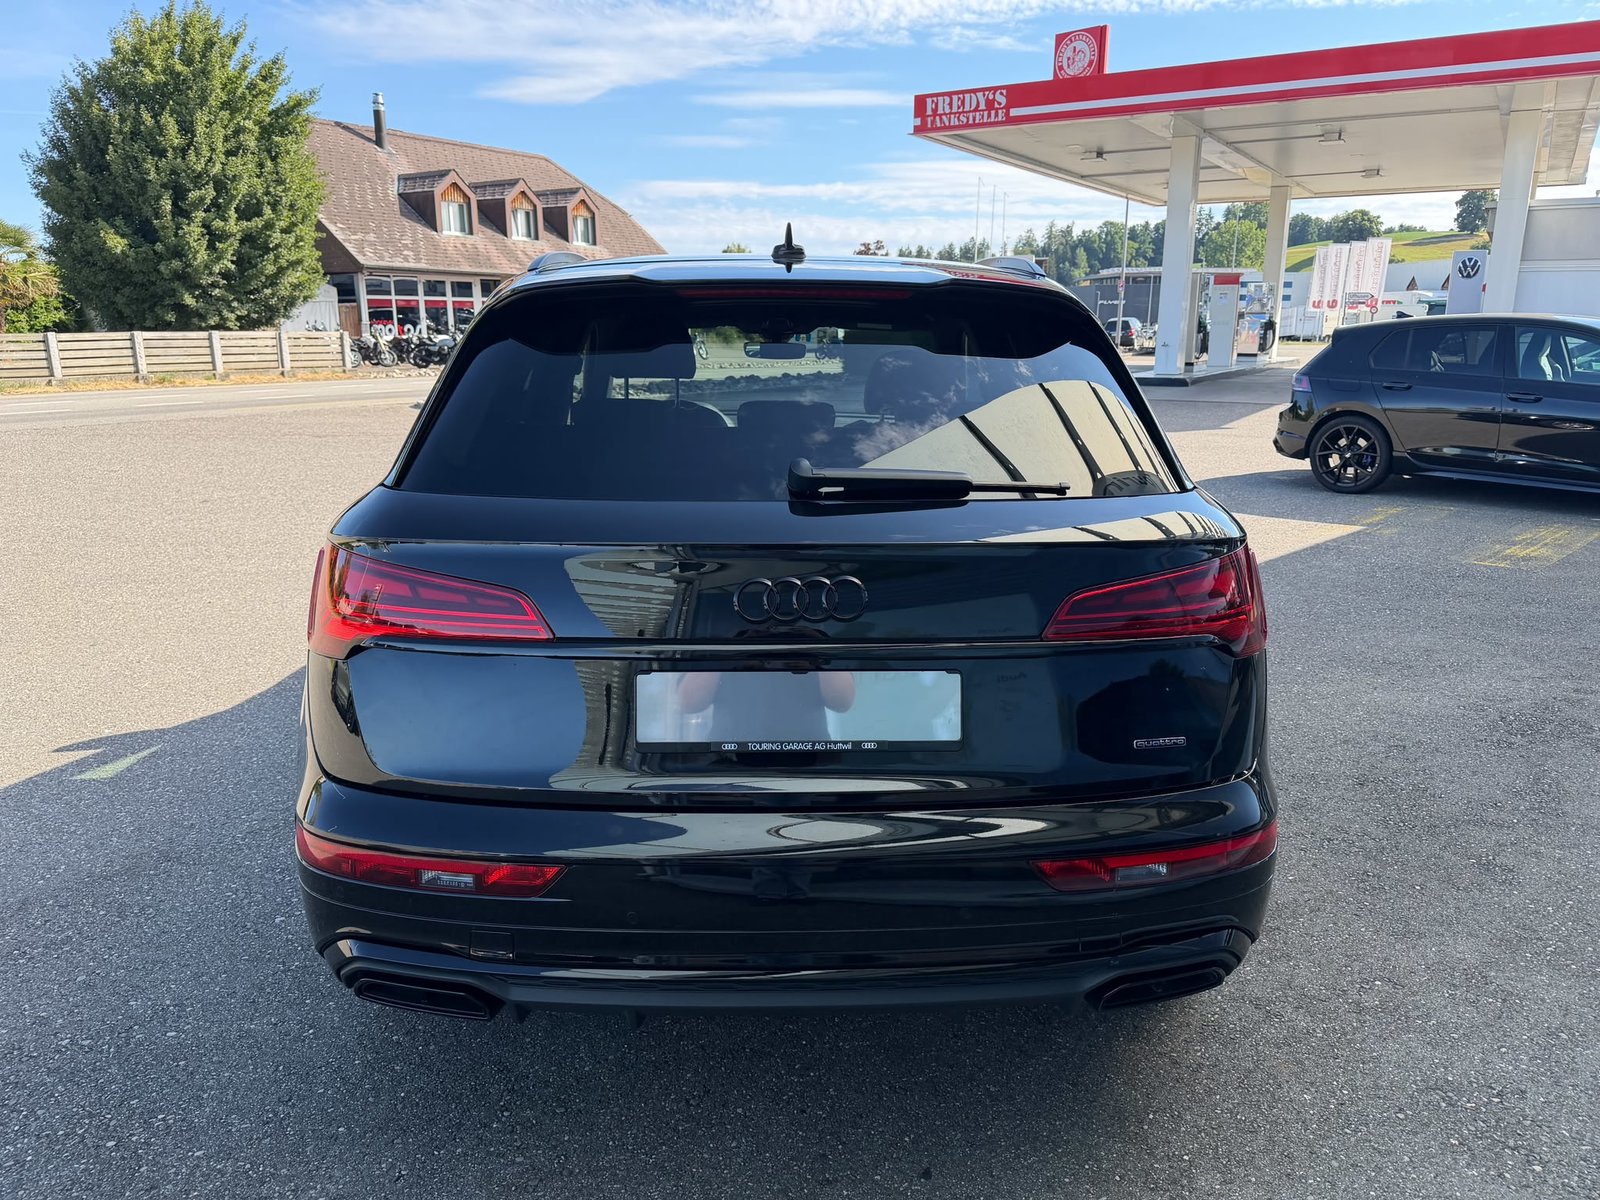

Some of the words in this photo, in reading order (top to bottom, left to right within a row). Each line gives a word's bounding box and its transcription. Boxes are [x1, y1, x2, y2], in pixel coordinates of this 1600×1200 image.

[927, 109, 1006, 128] TANKSTELLE
[783, 742, 812, 750] GARAGE
[814, 742, 826, 750] AG
[1136, 738, 1185, 748] quattro
